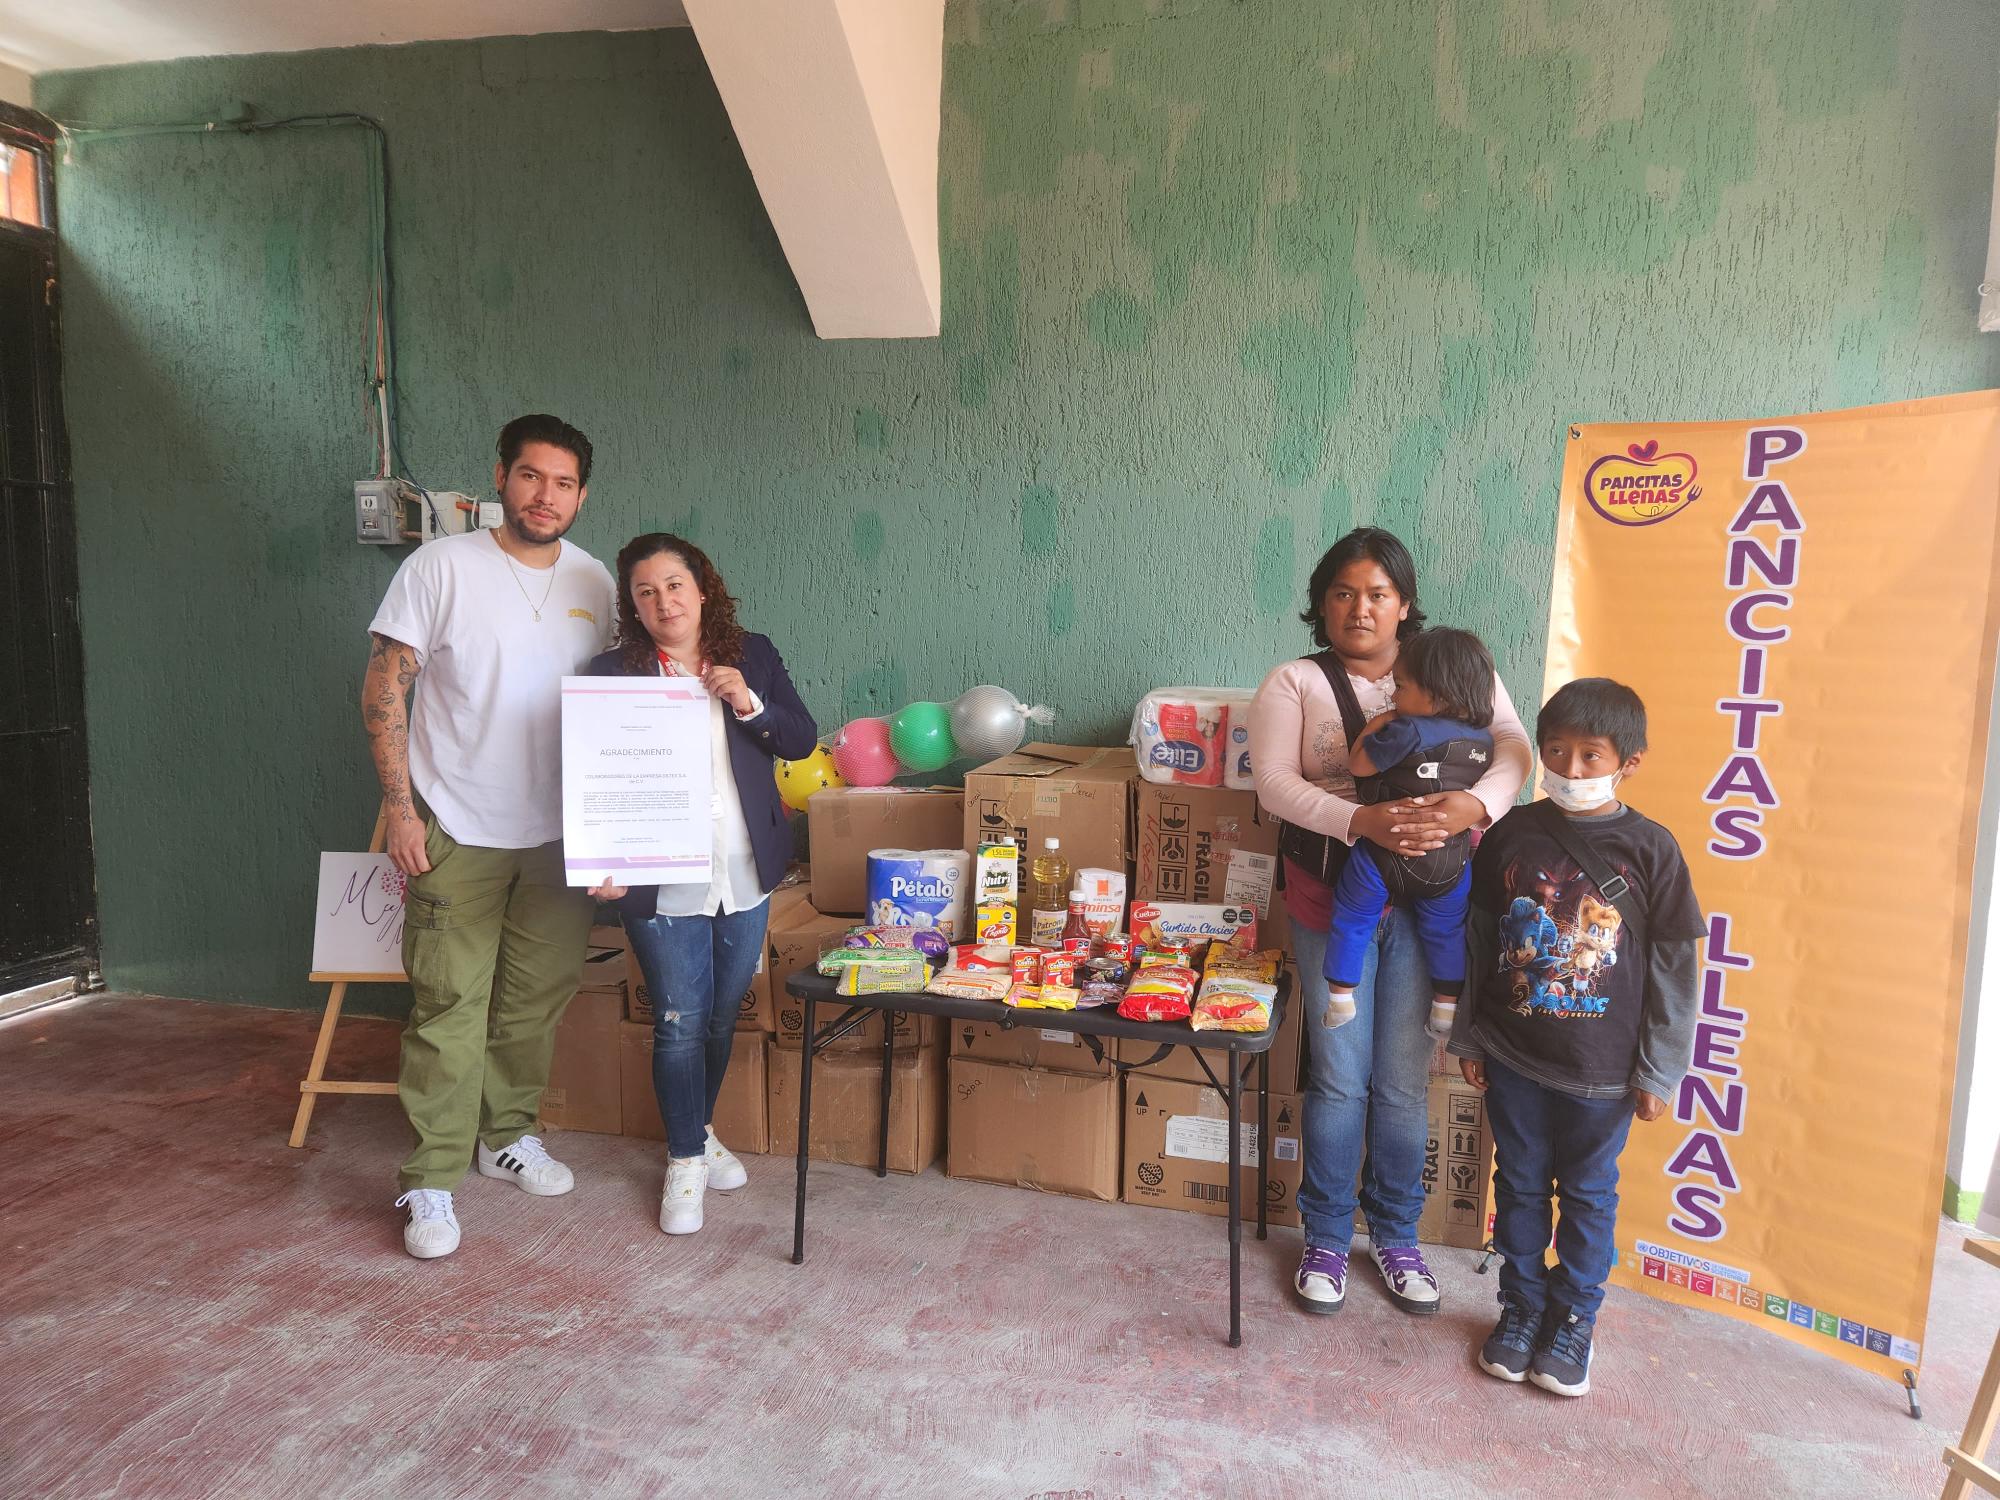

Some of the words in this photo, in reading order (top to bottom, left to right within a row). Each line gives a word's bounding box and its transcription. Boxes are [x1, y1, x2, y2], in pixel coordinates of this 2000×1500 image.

[1706, 429, 1804, 857] PANCITAS
[600, 748, 673, 757] AGRADECIMIENTO
[1156, 745, 1199, 769] Elite
[1071, 782, 1097, 800] Cereal
[1153, 789, 1175, 802] Papel
[891, 876, 954, 898] Pétalo
[1085, 902, 1121, 913] minsa
[983, 924, 1009, 938] Pronto
[1160, 921, 1197, 933] Surtido
[1541, 993, 1610, 1013] SONIC
[1667, 916, 1750, 1239] LLENAS
[957, 1078, 983, 1101] Sopa
[1648, 1245, 1711, 1272] OBJETIVOS
